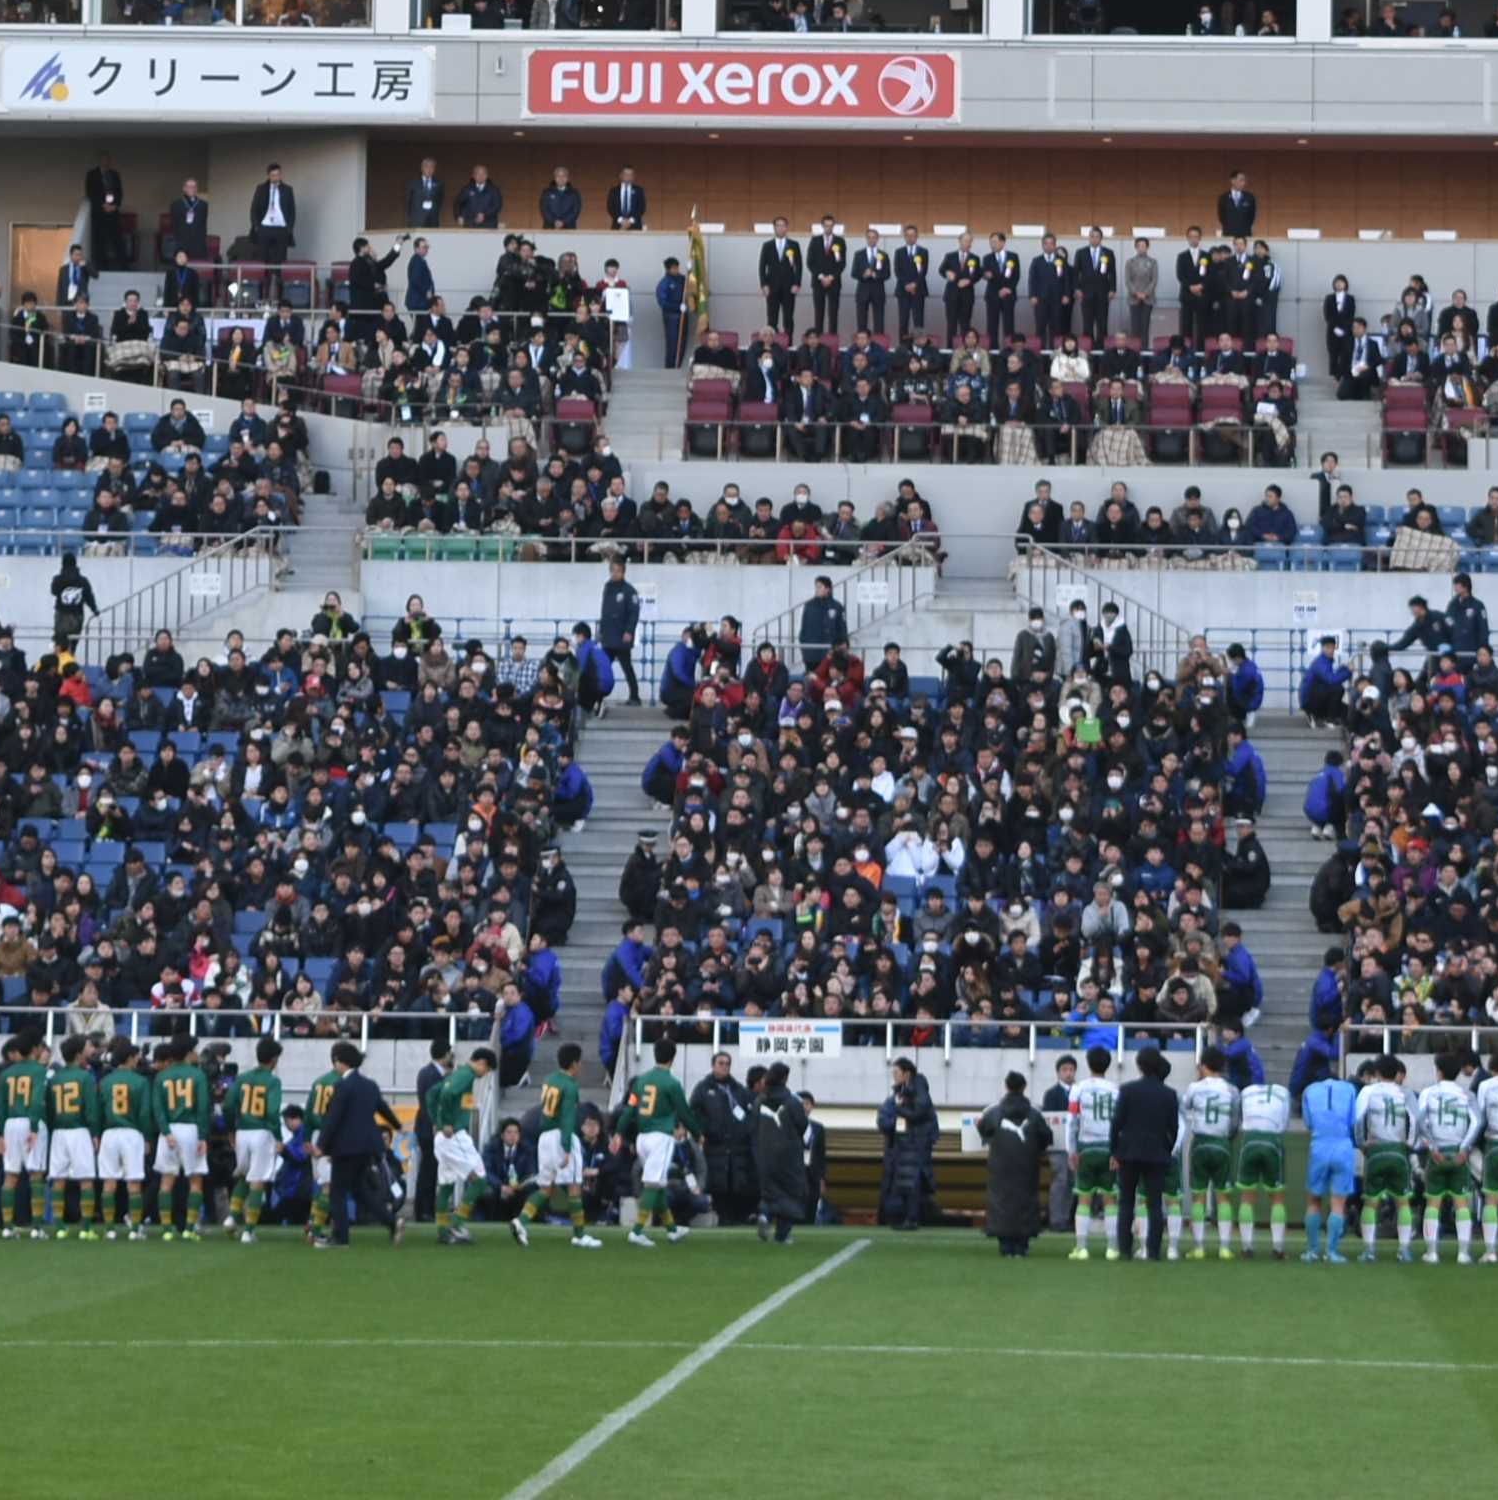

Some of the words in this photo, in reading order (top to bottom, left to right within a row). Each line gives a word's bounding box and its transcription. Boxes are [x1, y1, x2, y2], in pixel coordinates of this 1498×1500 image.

[86, 55, 415, 102] クリーン工房
[550, 60, 663, 105] FUJI
[756, 1036, 825, 1054] 静岡学園
[6, 1076, 32, 1107] 19
[52, 1081, 81, 1114] 12
[112, 1083, 130, 1116] 8
[164, 1078, 195, 1110] 14
[240, 1083, 267, 1116] 16
[639, 1084, 658, 1117] 3
[1326, 1084, 1334, 1111] 1
[1204, 1095, 1221, 1125] 6
